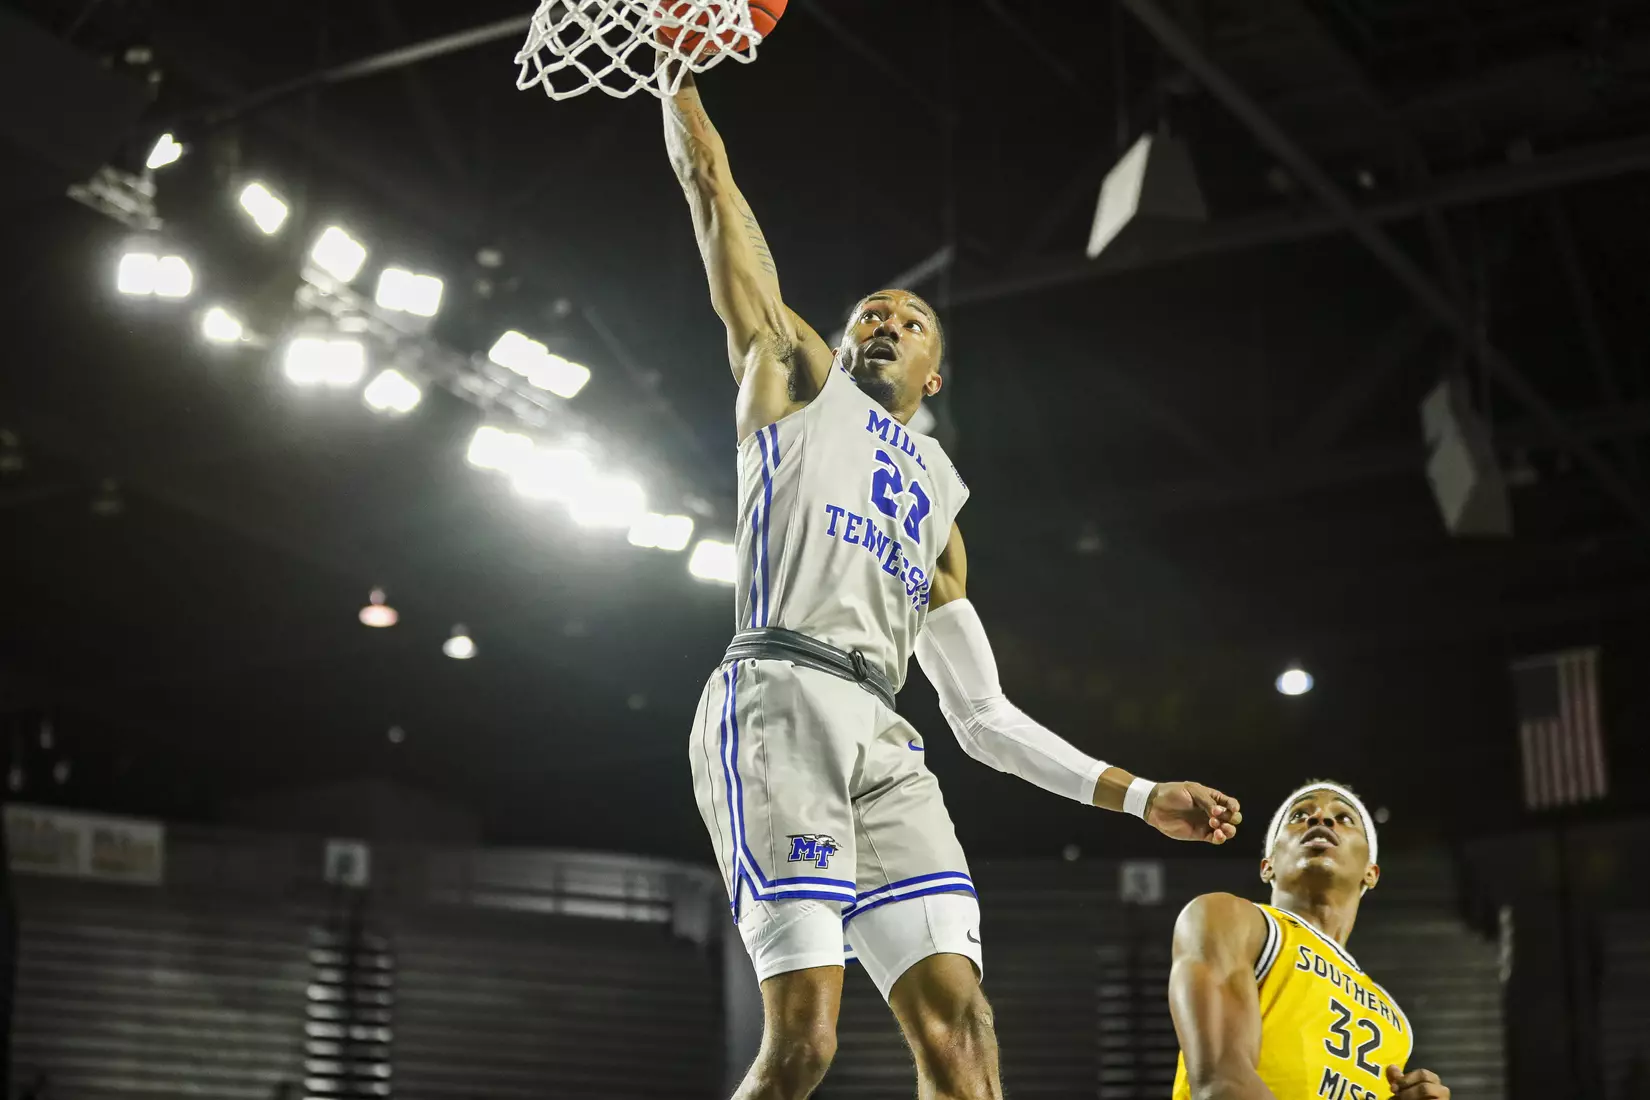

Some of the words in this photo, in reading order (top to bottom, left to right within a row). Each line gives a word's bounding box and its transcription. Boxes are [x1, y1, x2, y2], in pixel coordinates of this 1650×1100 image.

[788, 837, 836, 869] MT
[1296, 945, 1402, 1032] SOUTHERN
[1324, 998, 1381, 1077] 32
